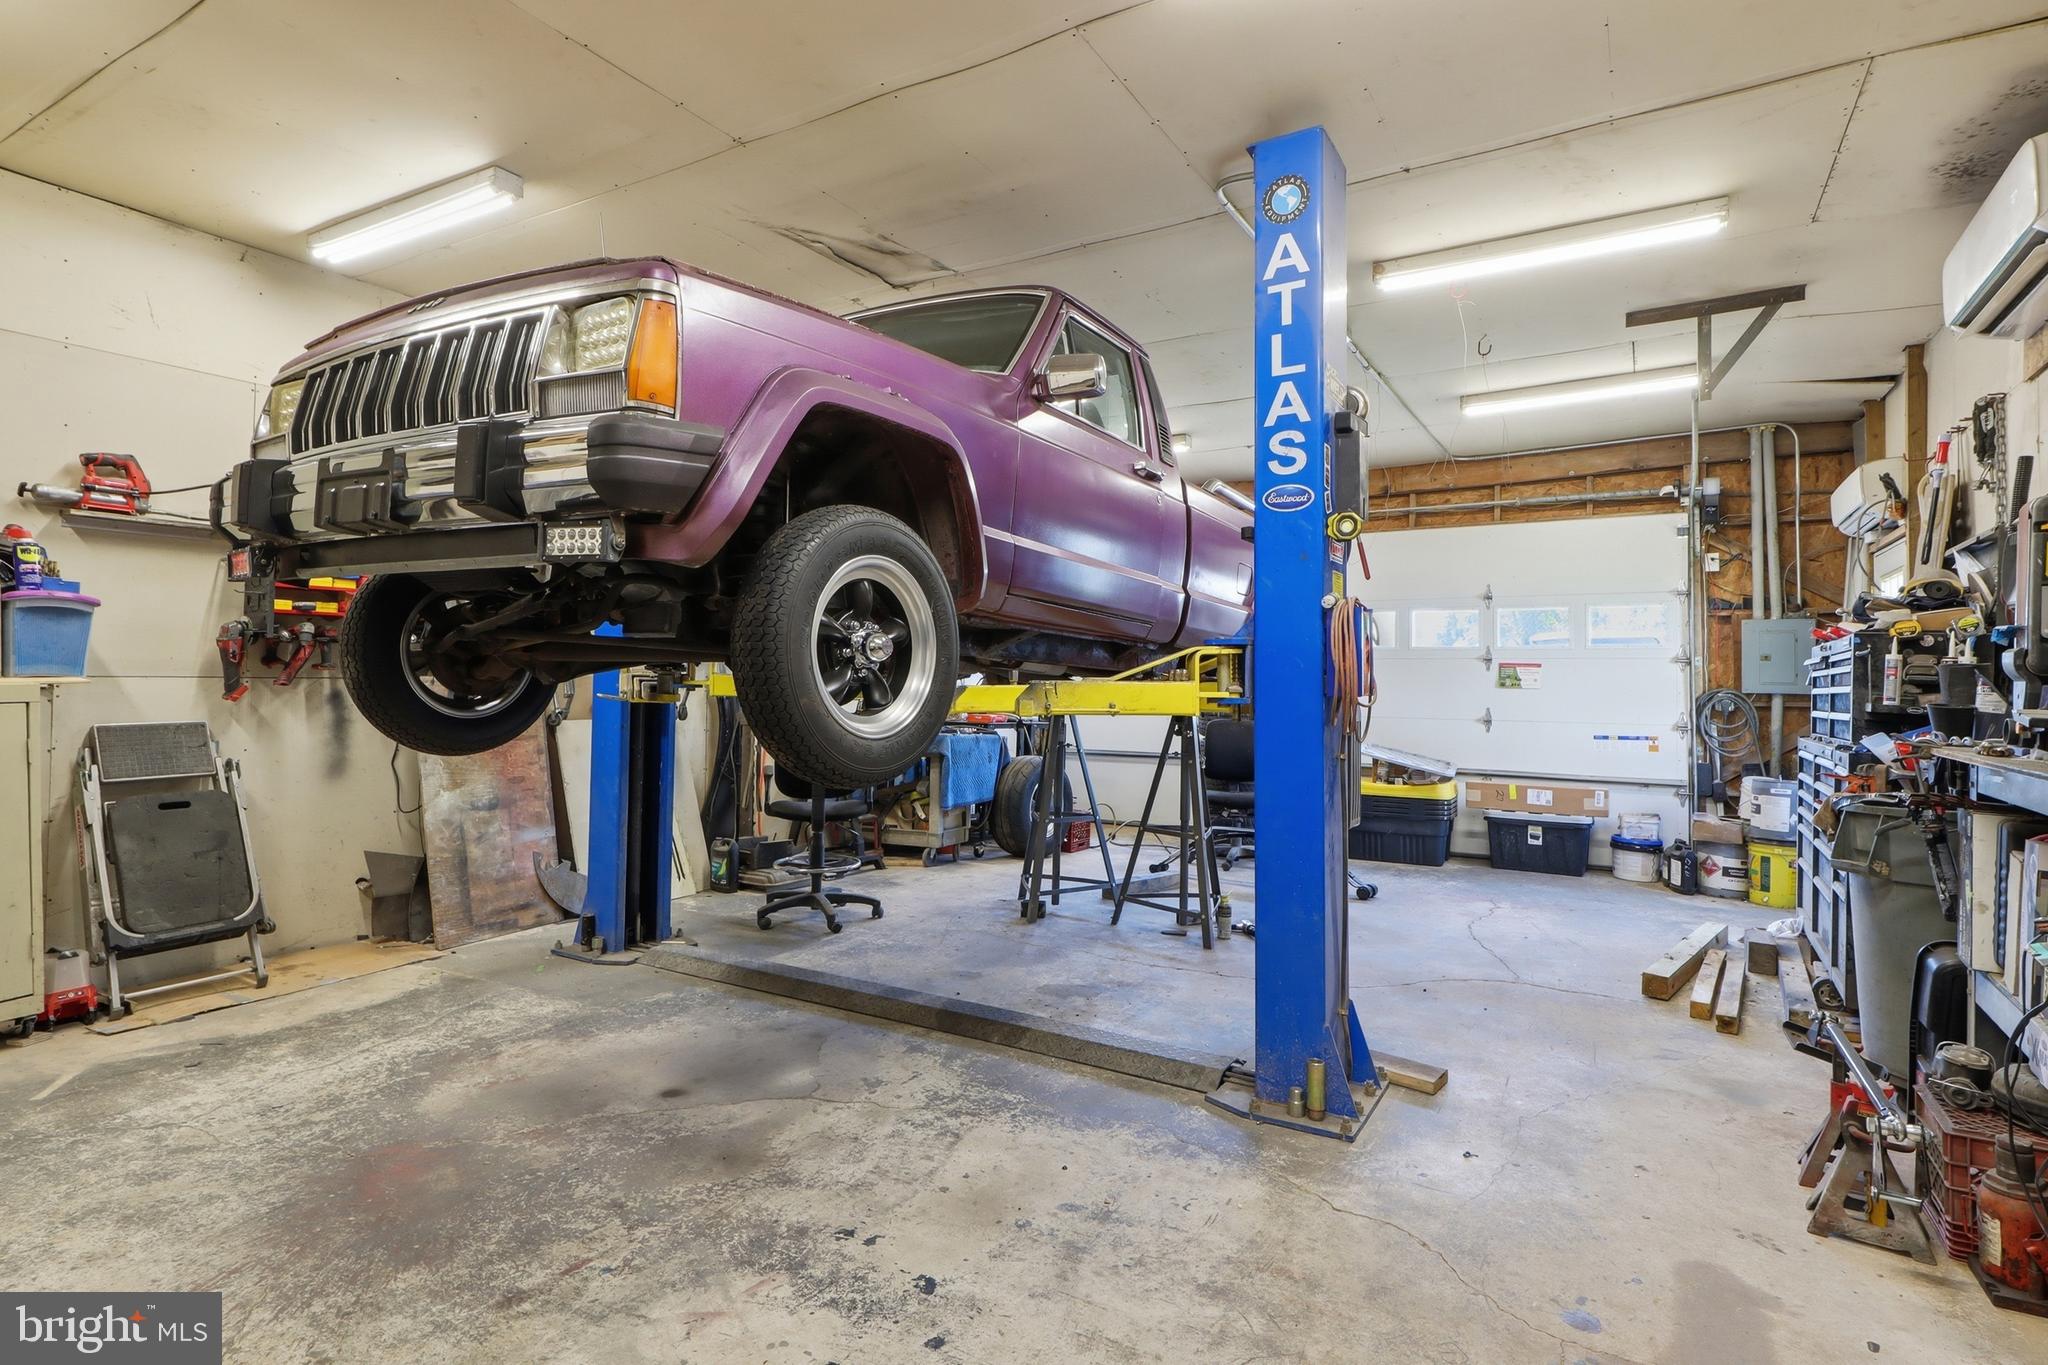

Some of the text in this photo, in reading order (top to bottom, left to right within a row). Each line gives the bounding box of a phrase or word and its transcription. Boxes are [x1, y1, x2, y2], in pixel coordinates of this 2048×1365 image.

[1272, 177, 1301, 191] ATLAS
[1264, 197, 1308, 222] EQUIPMENT
[1262, 232, 1312, 476] ATLAS
[1267, 491, 1309, 504] Eastwood
